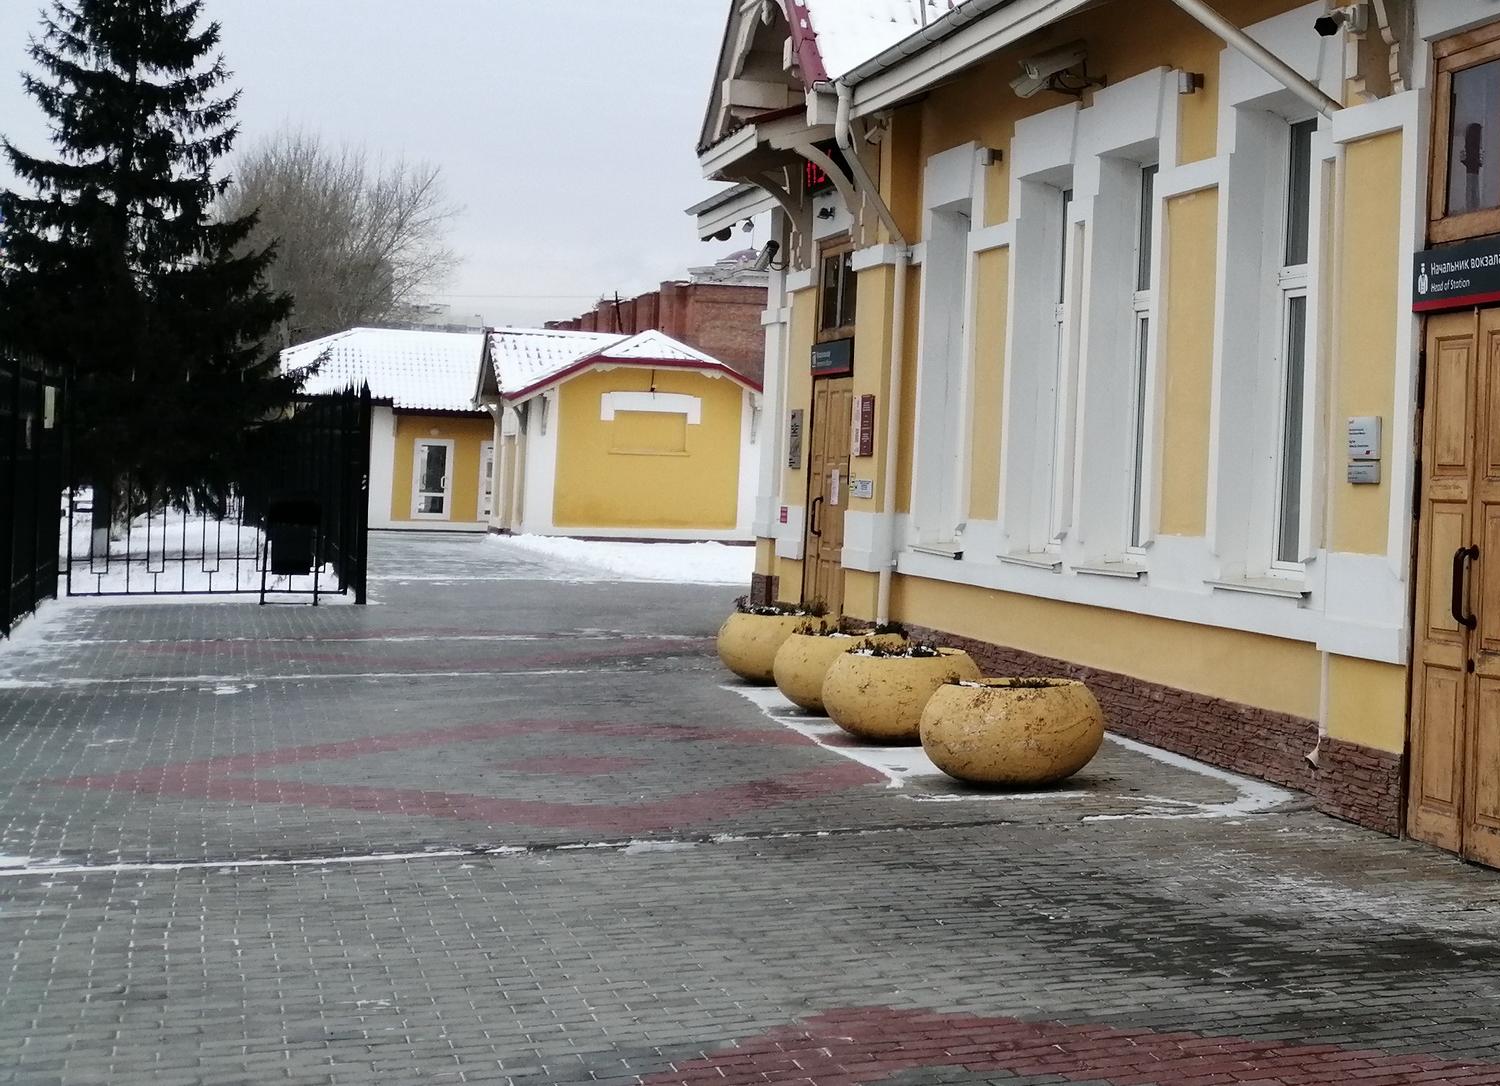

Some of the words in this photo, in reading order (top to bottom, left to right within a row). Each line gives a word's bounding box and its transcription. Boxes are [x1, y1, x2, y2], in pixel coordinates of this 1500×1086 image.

[1430, 260, 1470, 276] Начальник
[1430, 281, 1444, 293] Head
[1443, 279, 1450, 291] of
[1450, 278, 1471, 290] Station
